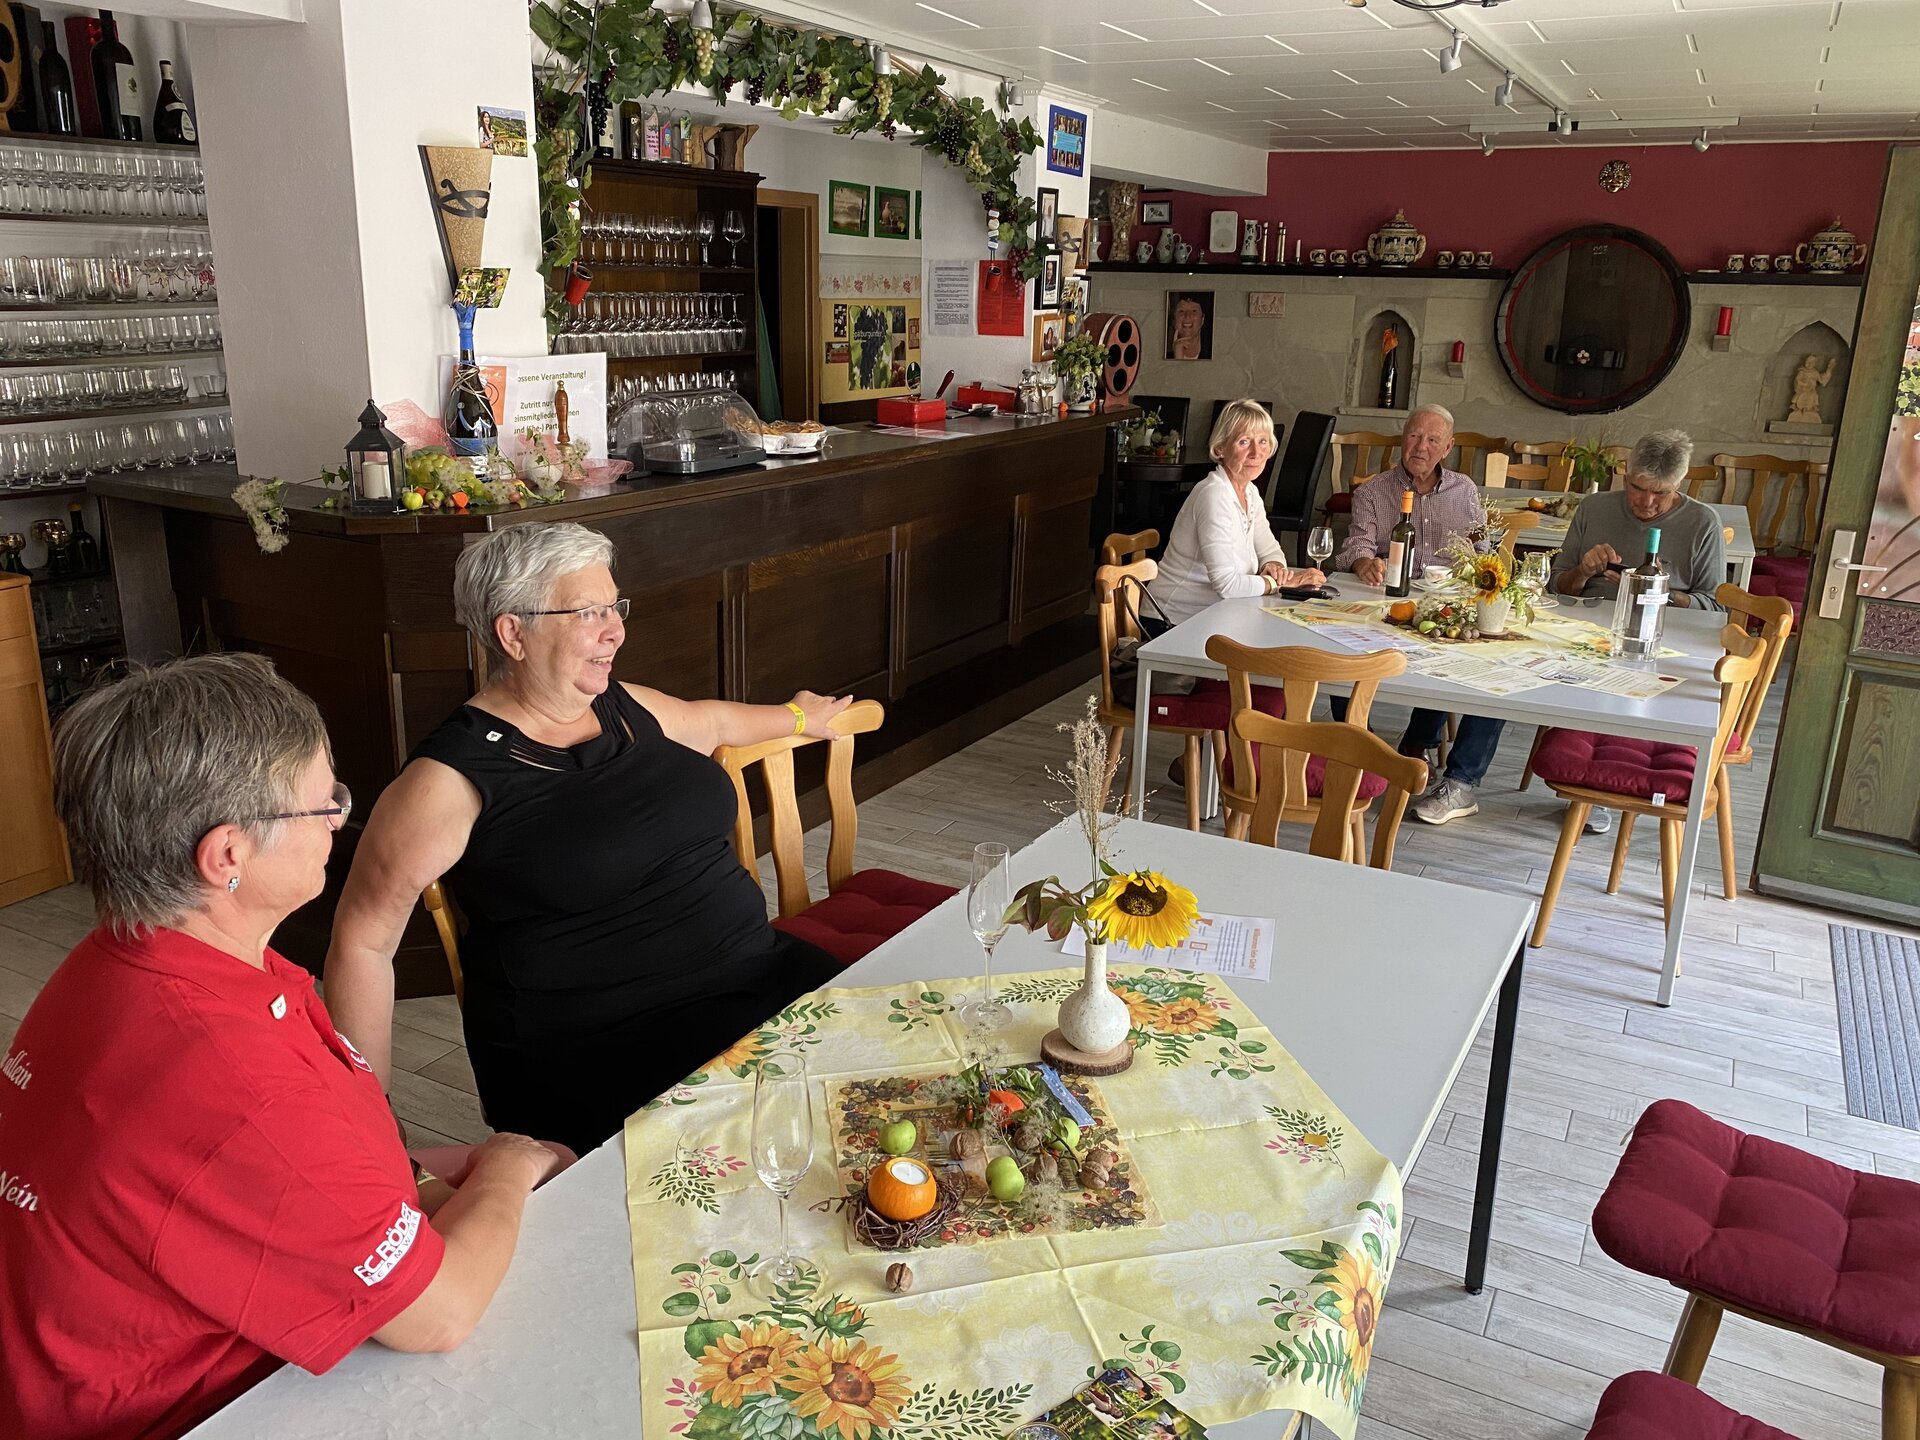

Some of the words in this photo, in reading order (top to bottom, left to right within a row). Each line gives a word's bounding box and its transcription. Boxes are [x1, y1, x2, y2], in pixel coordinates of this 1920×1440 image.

[541, 370, 587, 381] Veranstaltung!
[520, 401, 541, 410] Zutritt
[367, 1213, 419, 1282] TEAMWORK
